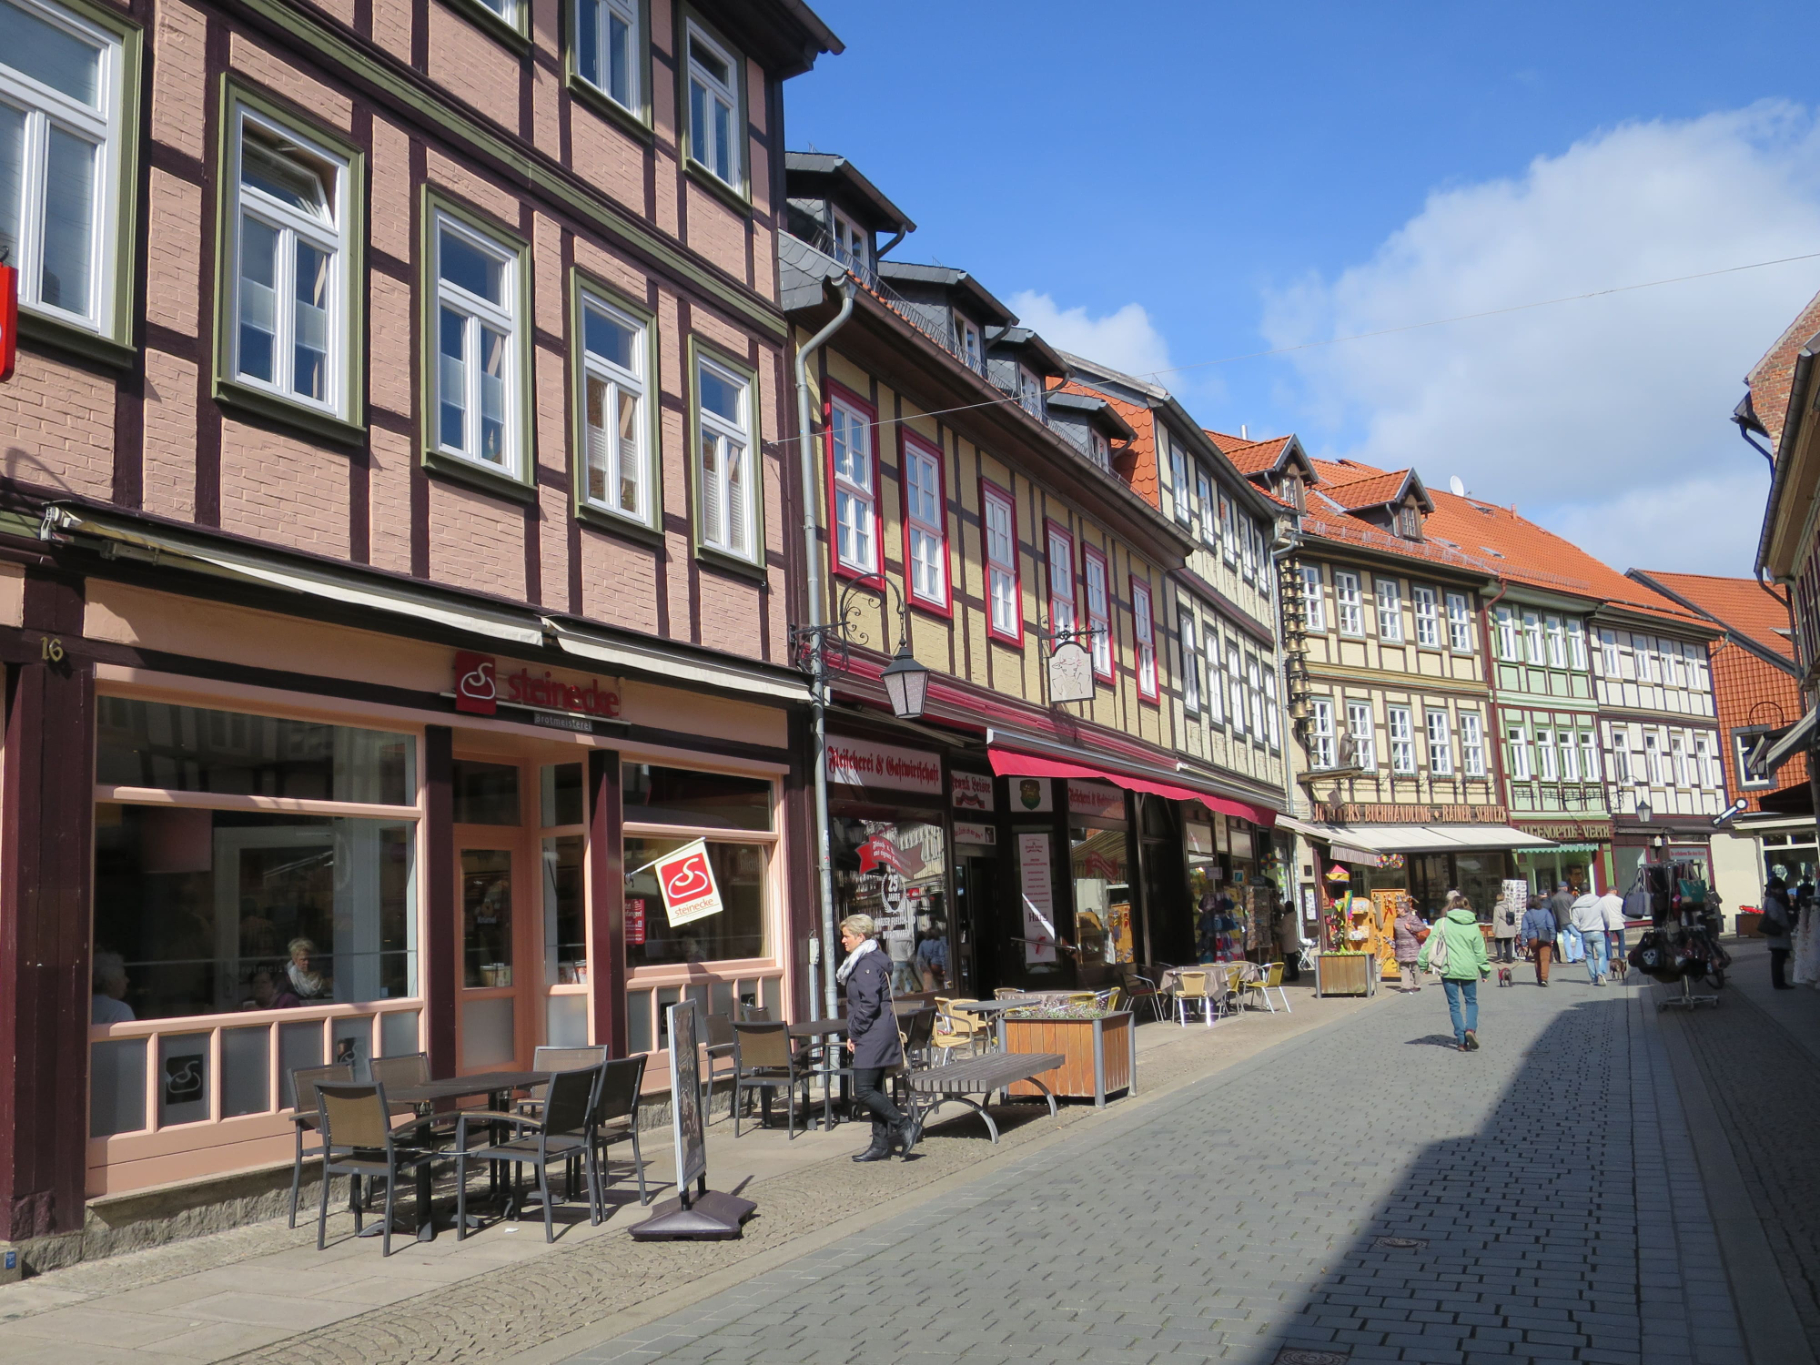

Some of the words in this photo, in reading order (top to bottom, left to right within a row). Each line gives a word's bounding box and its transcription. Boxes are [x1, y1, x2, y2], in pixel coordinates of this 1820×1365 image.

[41, 636, 63, 661] 16
[508, 668, 619, 716] steinecke
[535, 714, 592, 731] Brotmeisterei
[827, 745, 873, 774] Fleischerei
[876, 753, 885, 776] &
[886, 755, 939, 786] Gastwirtschaft
[1365, 803, 1430, 823] BUCHHANDLUNG
[1442, 804, 1471, 823] RAINER
[1476, 805, 1506, 823] SCHULZE
[888, 874, 898, 892] 25
[675, 898, 713, 917] steinecke
